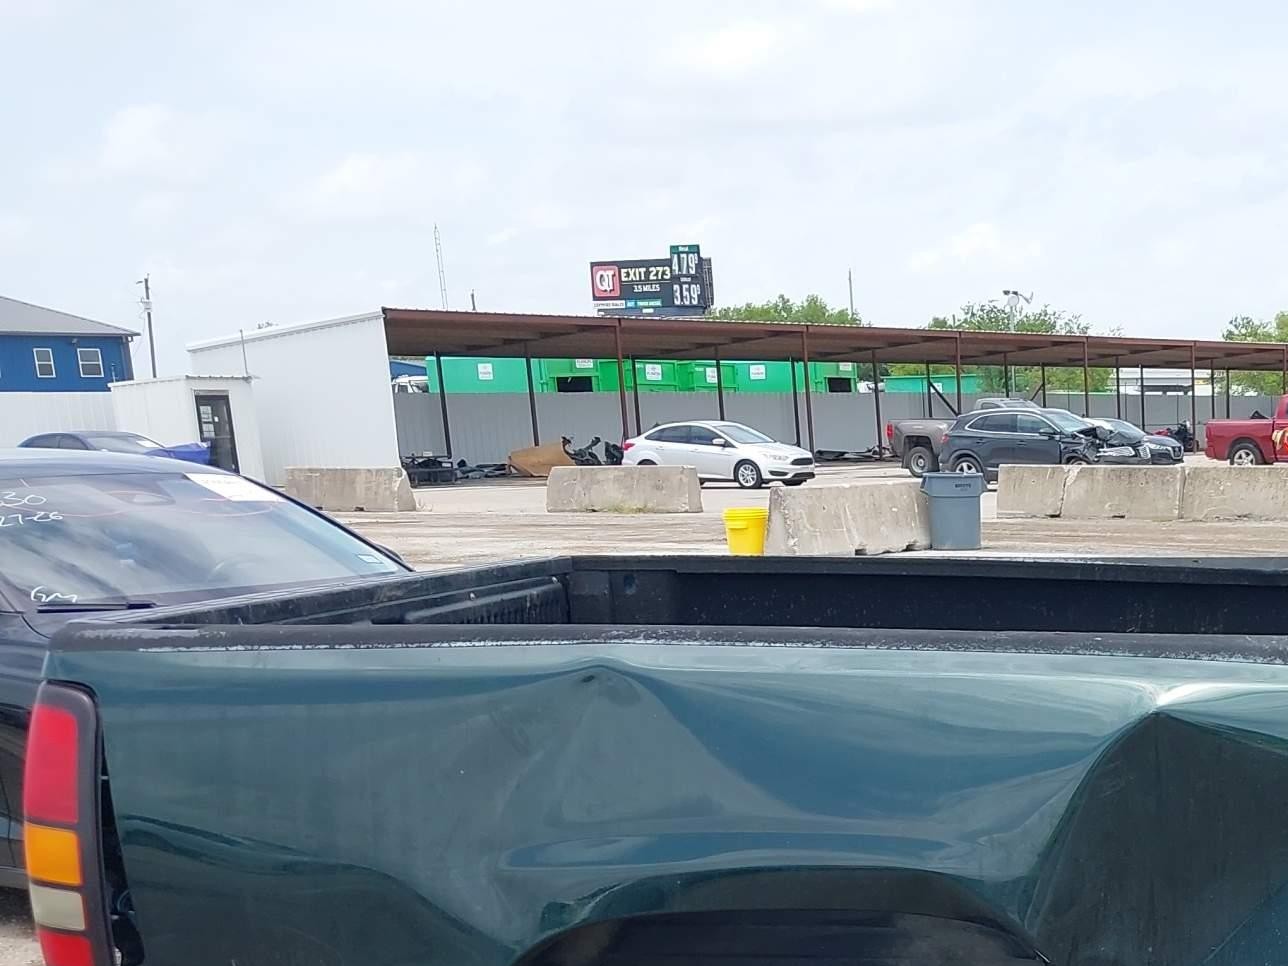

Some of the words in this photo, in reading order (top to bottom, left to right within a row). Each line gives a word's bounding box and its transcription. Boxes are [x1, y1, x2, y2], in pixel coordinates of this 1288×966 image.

[620, 267, 647, 281] EXIT
[649, 266, 671, 280] 273
[595, 270, 616, 294] QT
[642, 284, 660, 292] MILES
